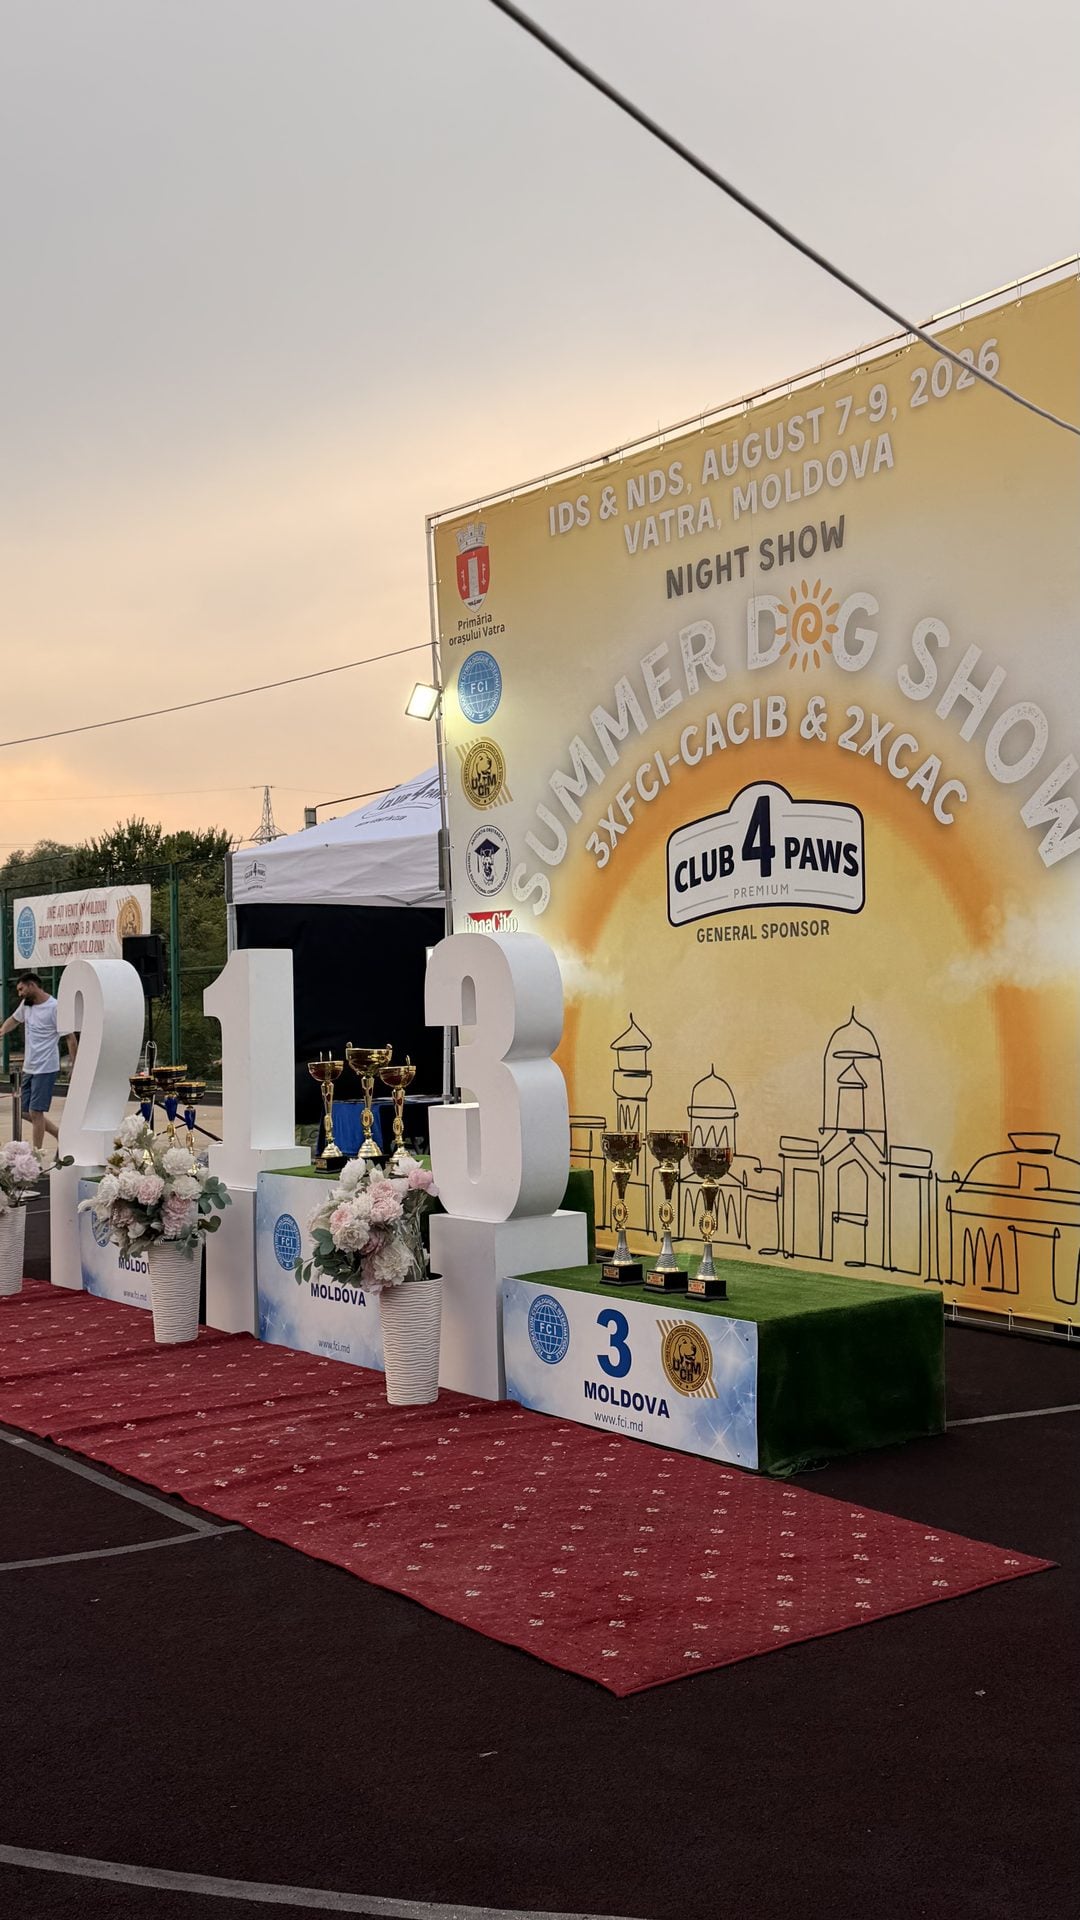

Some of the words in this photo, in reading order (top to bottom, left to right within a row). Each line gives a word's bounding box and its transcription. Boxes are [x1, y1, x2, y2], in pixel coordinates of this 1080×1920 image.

[548, 495, 591, 537] IDS
[599, 484, 619, 520] &
[626, 461, 693, 510] NDS,
[700, 406, 825, 486] AUGUST
[834, 383, 898, 436] 7-9,
[909, 339, 1000, 408] 2026
[623, 496, 722, 555] VATRA,
[733, 433, 895, 521] MOLDOVA
[666, 546, 750, 600] NIGHT
[758, 514, 847, 573] SHOW
[448, 628, 483, 647] orașului
[483, 622, 506, 638] Vatra
[457, 613, 492, 631] Primăria
[470, 680, 489, 694] FCI
[510, 620, 728, 917] SUMMER
[897, 617, 1080, 868] SHOW
[584, 696, 788, 869] 3XFCI-CACIB
[799, 694, 828, 743] &
[838, 704, 969, 826] 2XCAC
[674, 846, 735, 893] CLUB
[741, 795, 776, 878] 4
[784, 835, 860, 876] PAWS
[733, 883, 790, 899] PREMIUM
[696, 923, 758, 943] GENERAL
[761, 919, 830, 941] SPONSOR
[56, 959, 145, 1166] 2
[203, 949, 300, 1190] 1
[425, 933, 569, 1222] 3
[280, 1236, 293, 1247] FCI
[310, 1283, 366, 1307] MOLDOVA
[318, 1338, 350, 1354] www.fci.md
[540, 1322, 557, 1336] FCI
[596, 1308, 632, 1379] 3
[584, 1380, 671, 1419] MOLDOVA
[594, 1411, 644, 1433] www.fci.md
